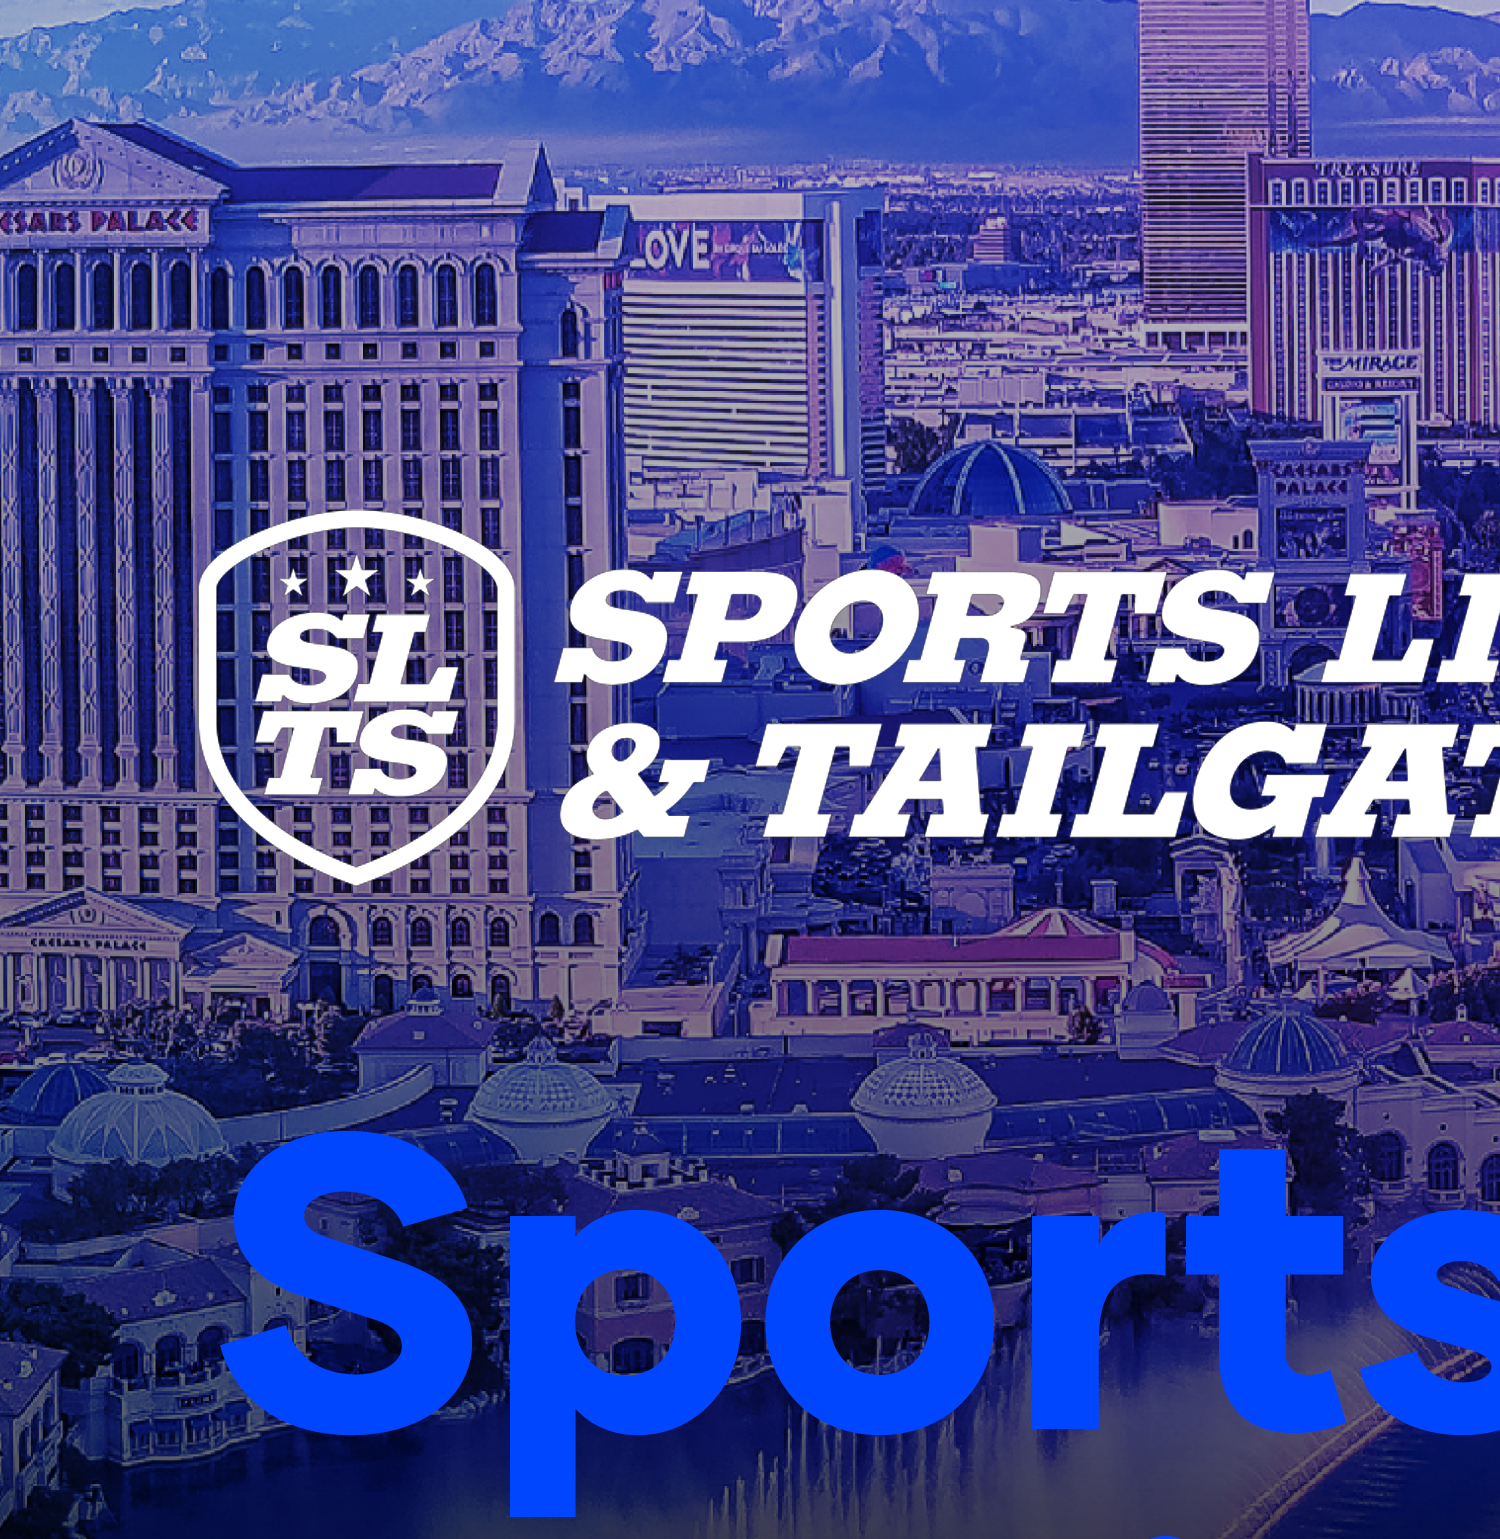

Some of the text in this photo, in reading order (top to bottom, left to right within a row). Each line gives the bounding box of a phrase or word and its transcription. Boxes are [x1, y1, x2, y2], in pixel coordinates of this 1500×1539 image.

[1314, 162, 1420, 177] TREASURE
[90, 207, 200, 233] PALACE
[1329, 355, 1418, 373] MIRAGE
[1275, 481, 1347, 495] PALACE
[95, 939, 147, 951] PALACE
